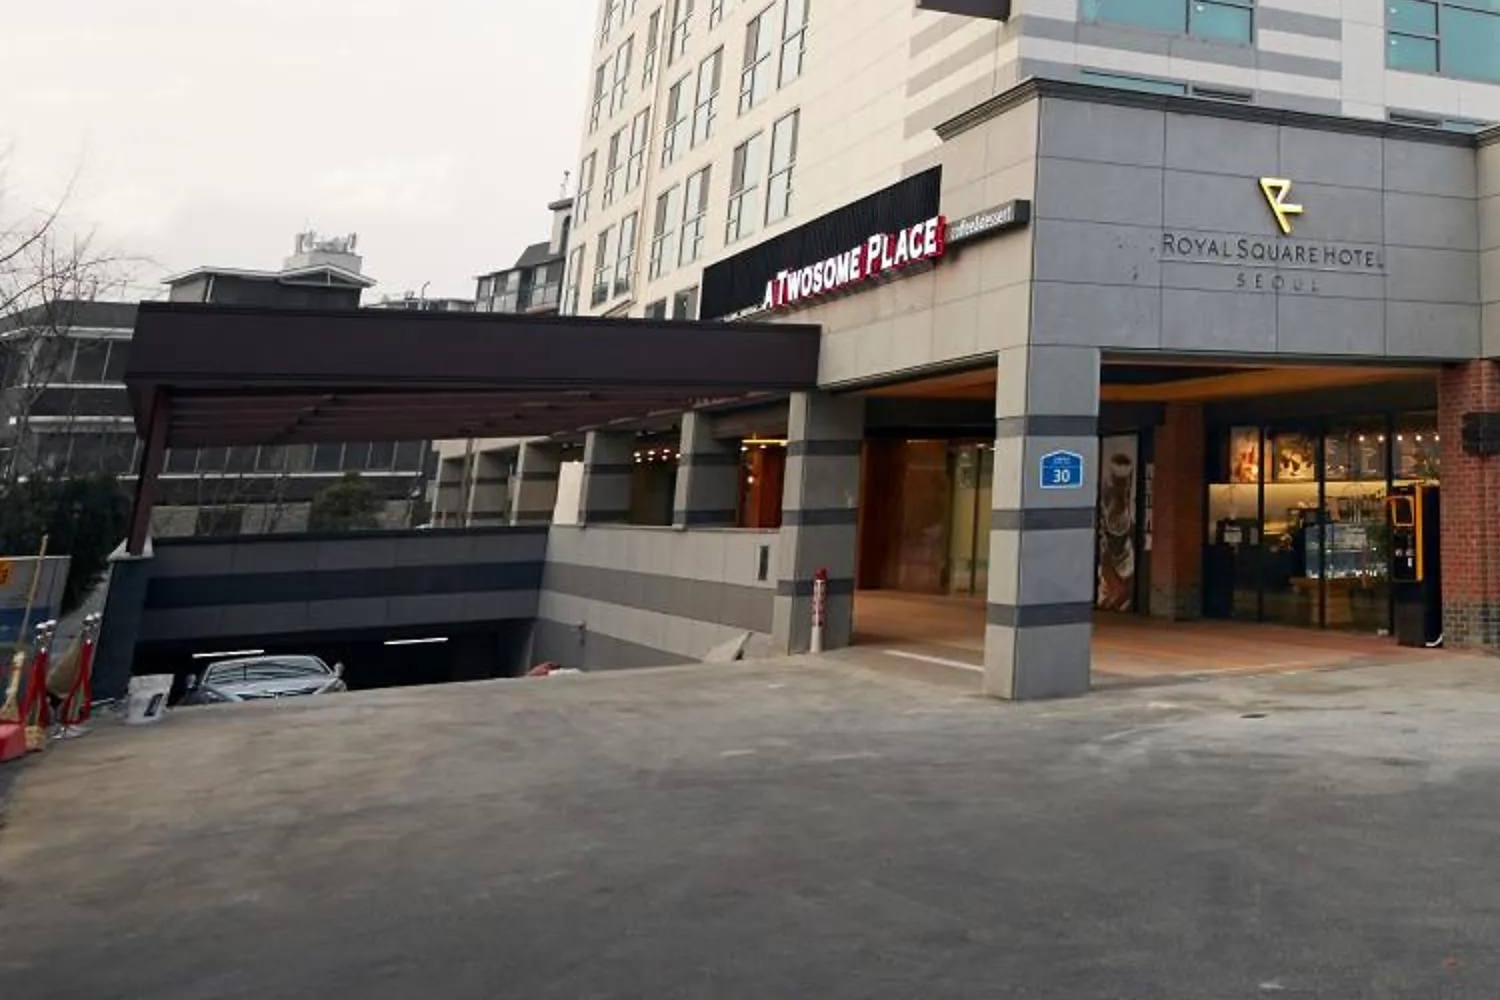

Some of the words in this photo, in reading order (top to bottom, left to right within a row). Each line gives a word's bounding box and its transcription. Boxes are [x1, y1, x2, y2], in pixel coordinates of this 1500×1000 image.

[1162, 232, 1232, 260] ROYAL
[1235, 239, 1320, 264] SQUARE
[763, 278, 775, 309] A
[774, 244, 863, 305] TWOSOME
[865, 215, 940, 276] PLACE
[1234, 272, 1321, 293] SEOUL
[1052, 469, 1071, 483] 30
